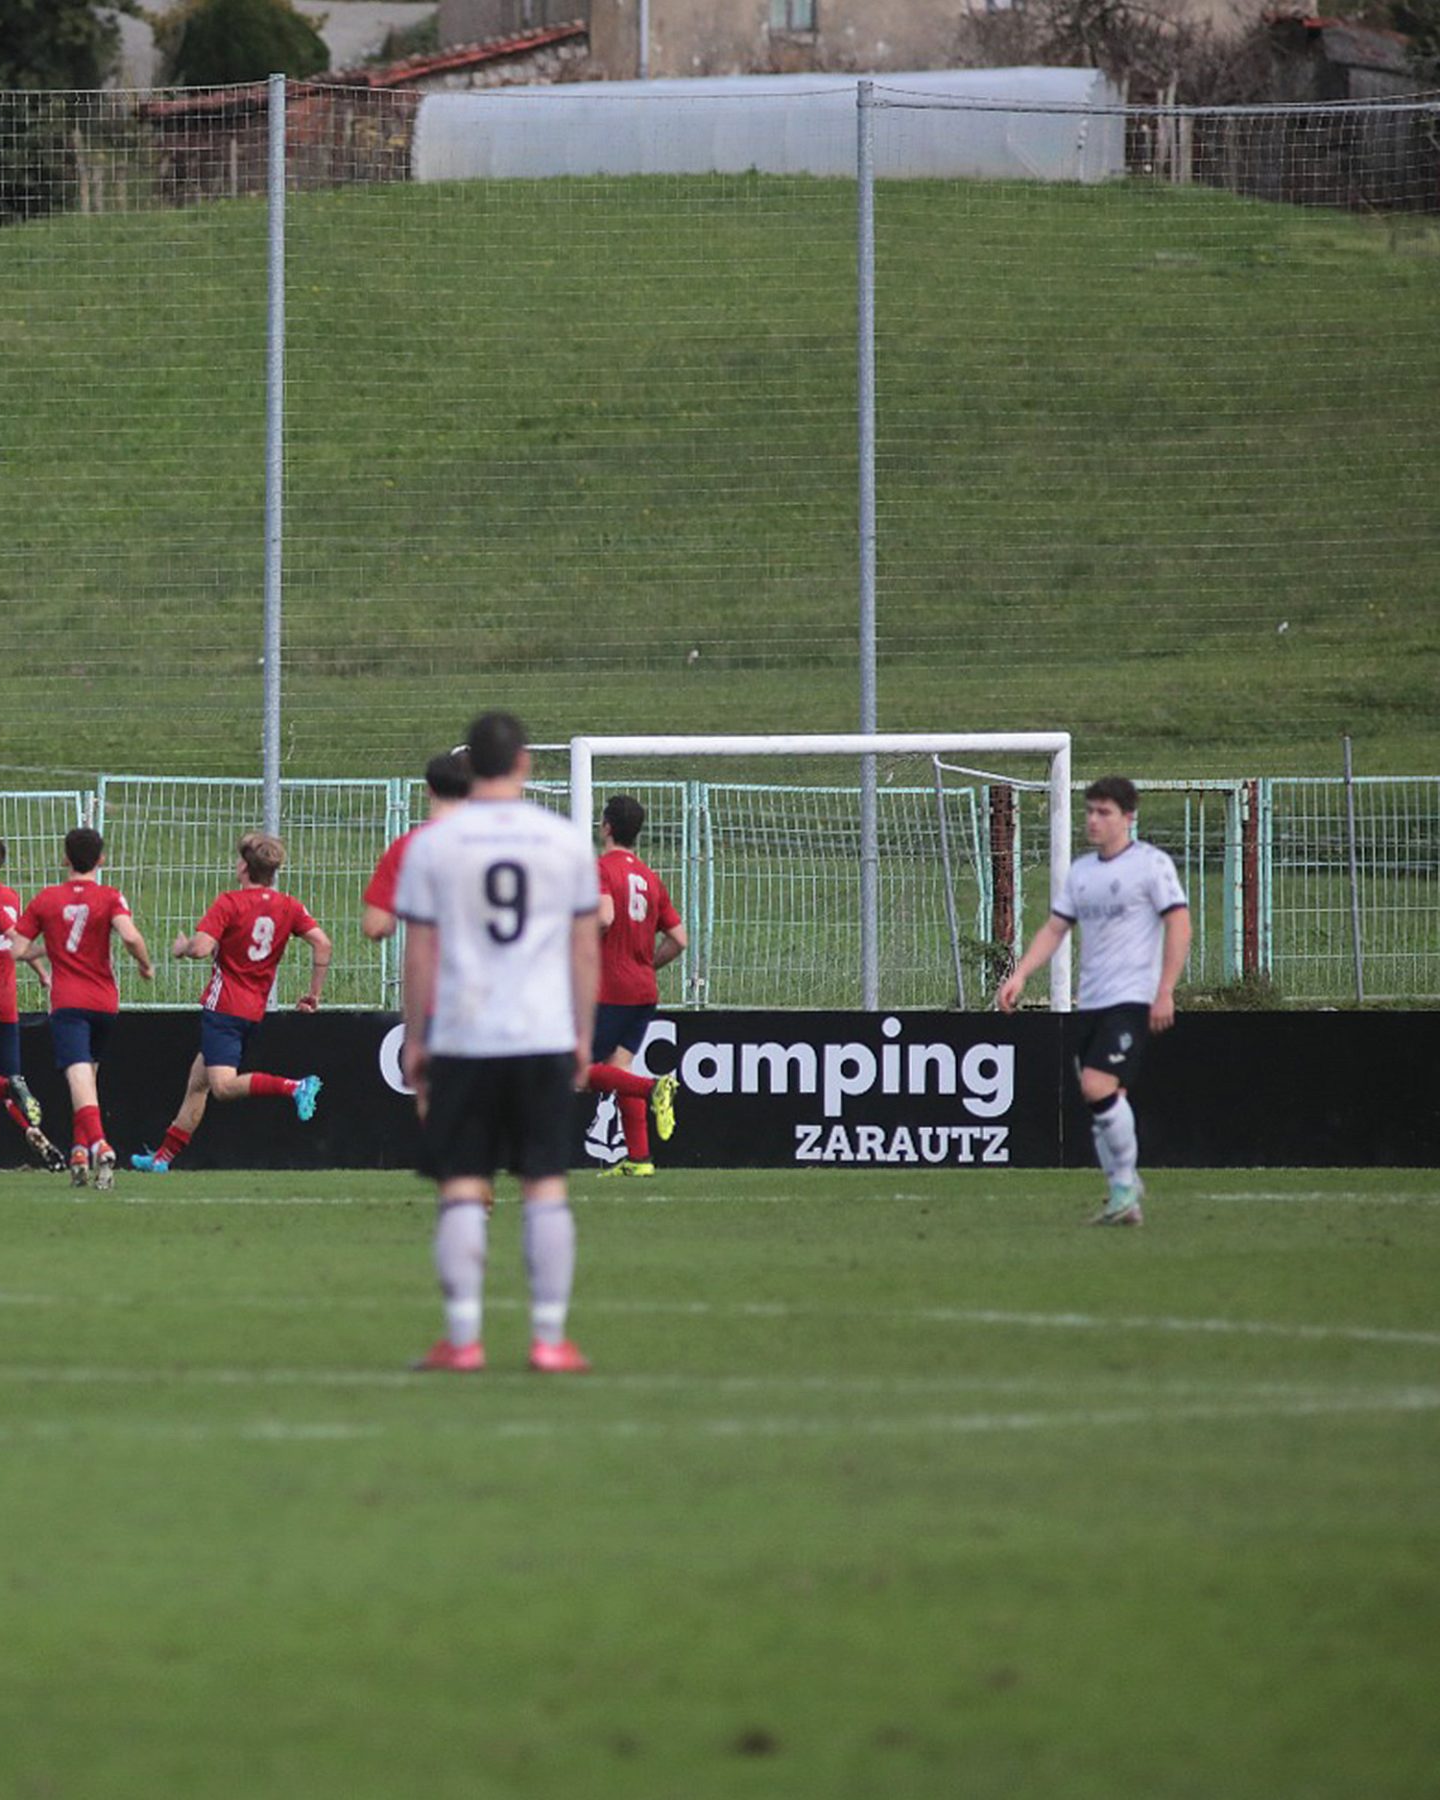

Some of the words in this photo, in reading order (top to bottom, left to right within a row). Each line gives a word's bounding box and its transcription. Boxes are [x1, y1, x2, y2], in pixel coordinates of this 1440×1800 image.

[484, 861, 528, 944] 9
[627, 873, 648, 922] 6
[63, 903, 90, 953] 7
[248, 916, 275, 961] 9
[632, 1016, 1015, 1118] Camping
[795, 1124, 1010, 1163] ZARAUTZ
